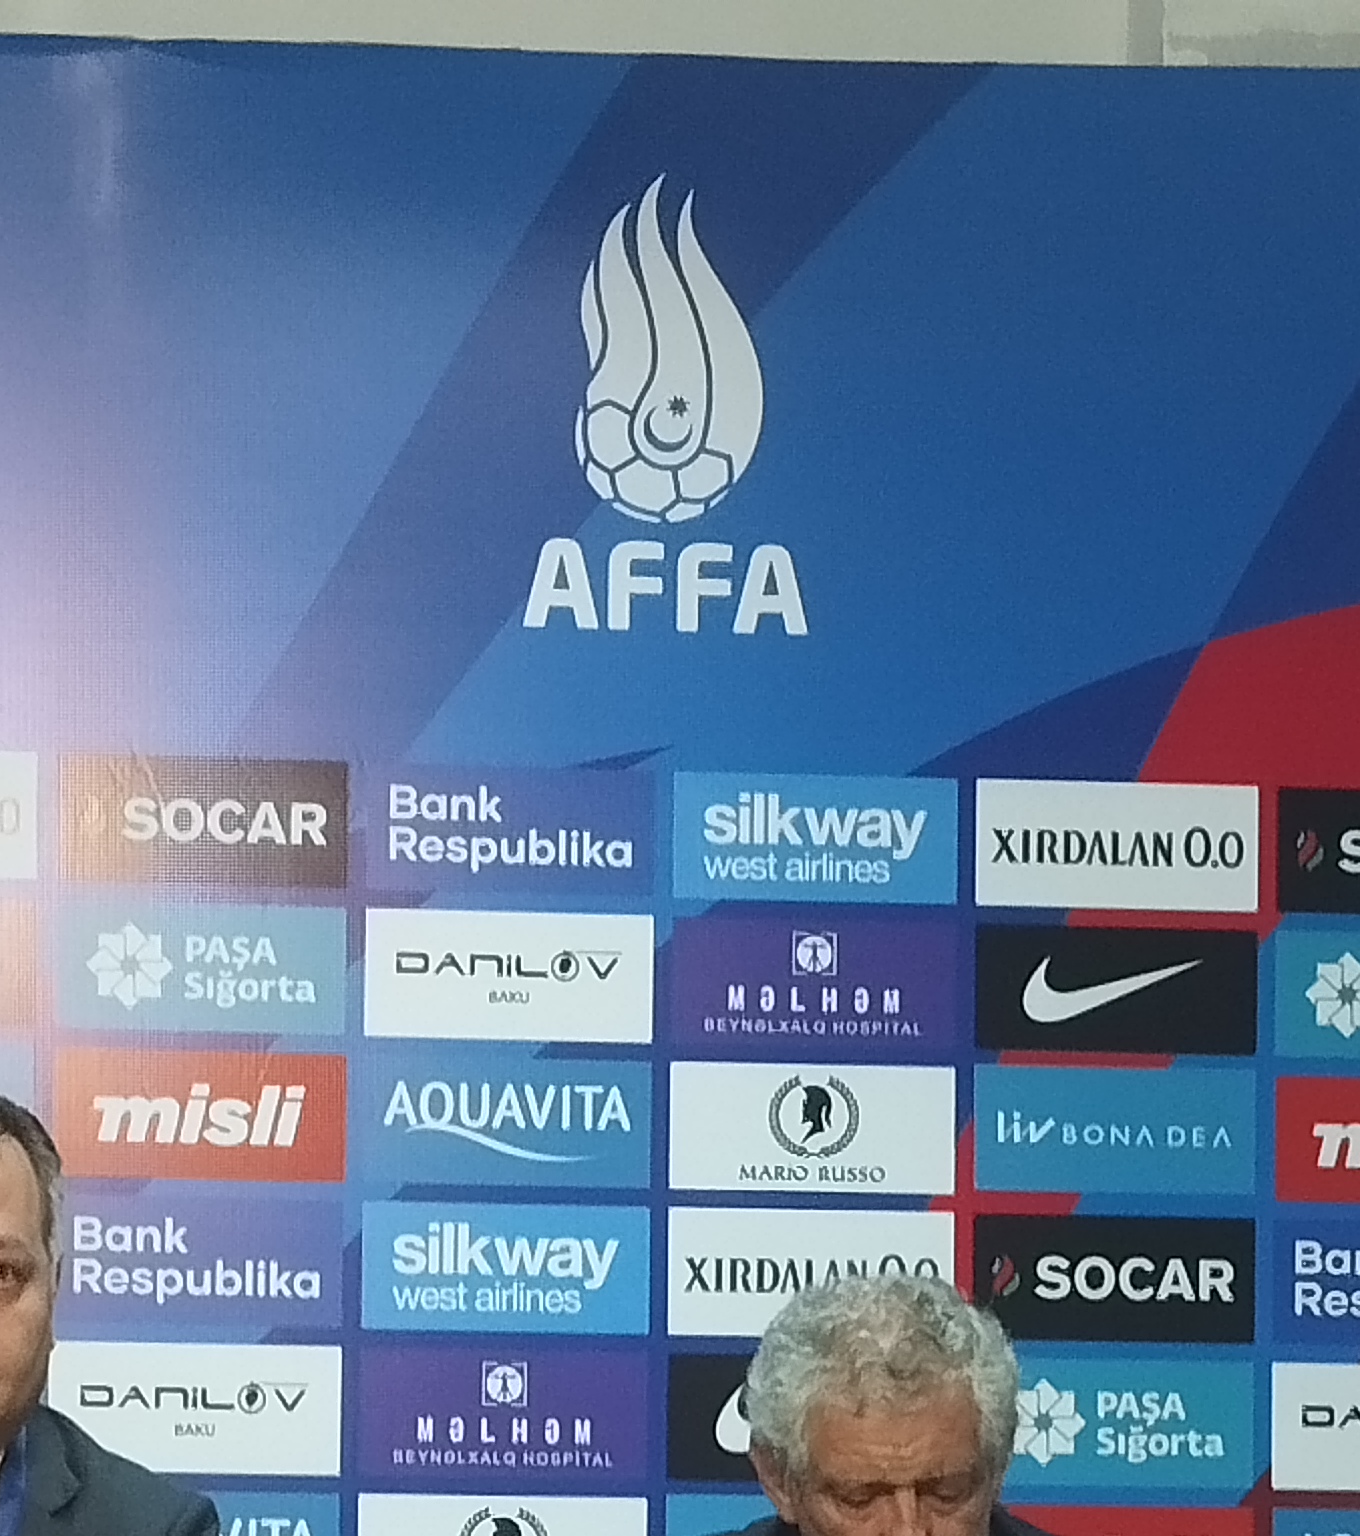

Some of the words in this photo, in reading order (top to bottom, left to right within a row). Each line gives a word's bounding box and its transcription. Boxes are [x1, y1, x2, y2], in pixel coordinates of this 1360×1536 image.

[523, 537, 808, 636] AFFA
[122, 795, 328, 846] SOCAR
[388, 783, 502, 825] Bank
[388, 825, 634, 873] Respublika
[703, 852, 781, 881] west
[785, 853, 891, 884] airlines
[991, 826, 1174, 868] XIRDALAN
[1184, 827, 1244, 870] 0.0
[184, 936, 277, 972] PAŞA
[488, 989, 531, 1005] BAKU
[94, 1084, 307, 1148] misli
[384, 1080, 631, 1133] AQUAVITA
[1062, 1122, 1158, 1148] BONA
[1168, 1124, 1233, 1150] DEA
[740, 1163, 808, 1183] MARIO
[818, 1165, 886, 1185] RUSSO
[72, 1215, 189, 1255] Bank
[72, 1257, 321, 1305] Respublika
[393, 1282, 468, 1312] west
[475, 1284, 582, 1315] airlines
[1035, 1254, 1236, 1303] SOCAR
[1097, 1390, 1187, 1425] PAŞA
[173, 1422, 215, 1438] BAKU
